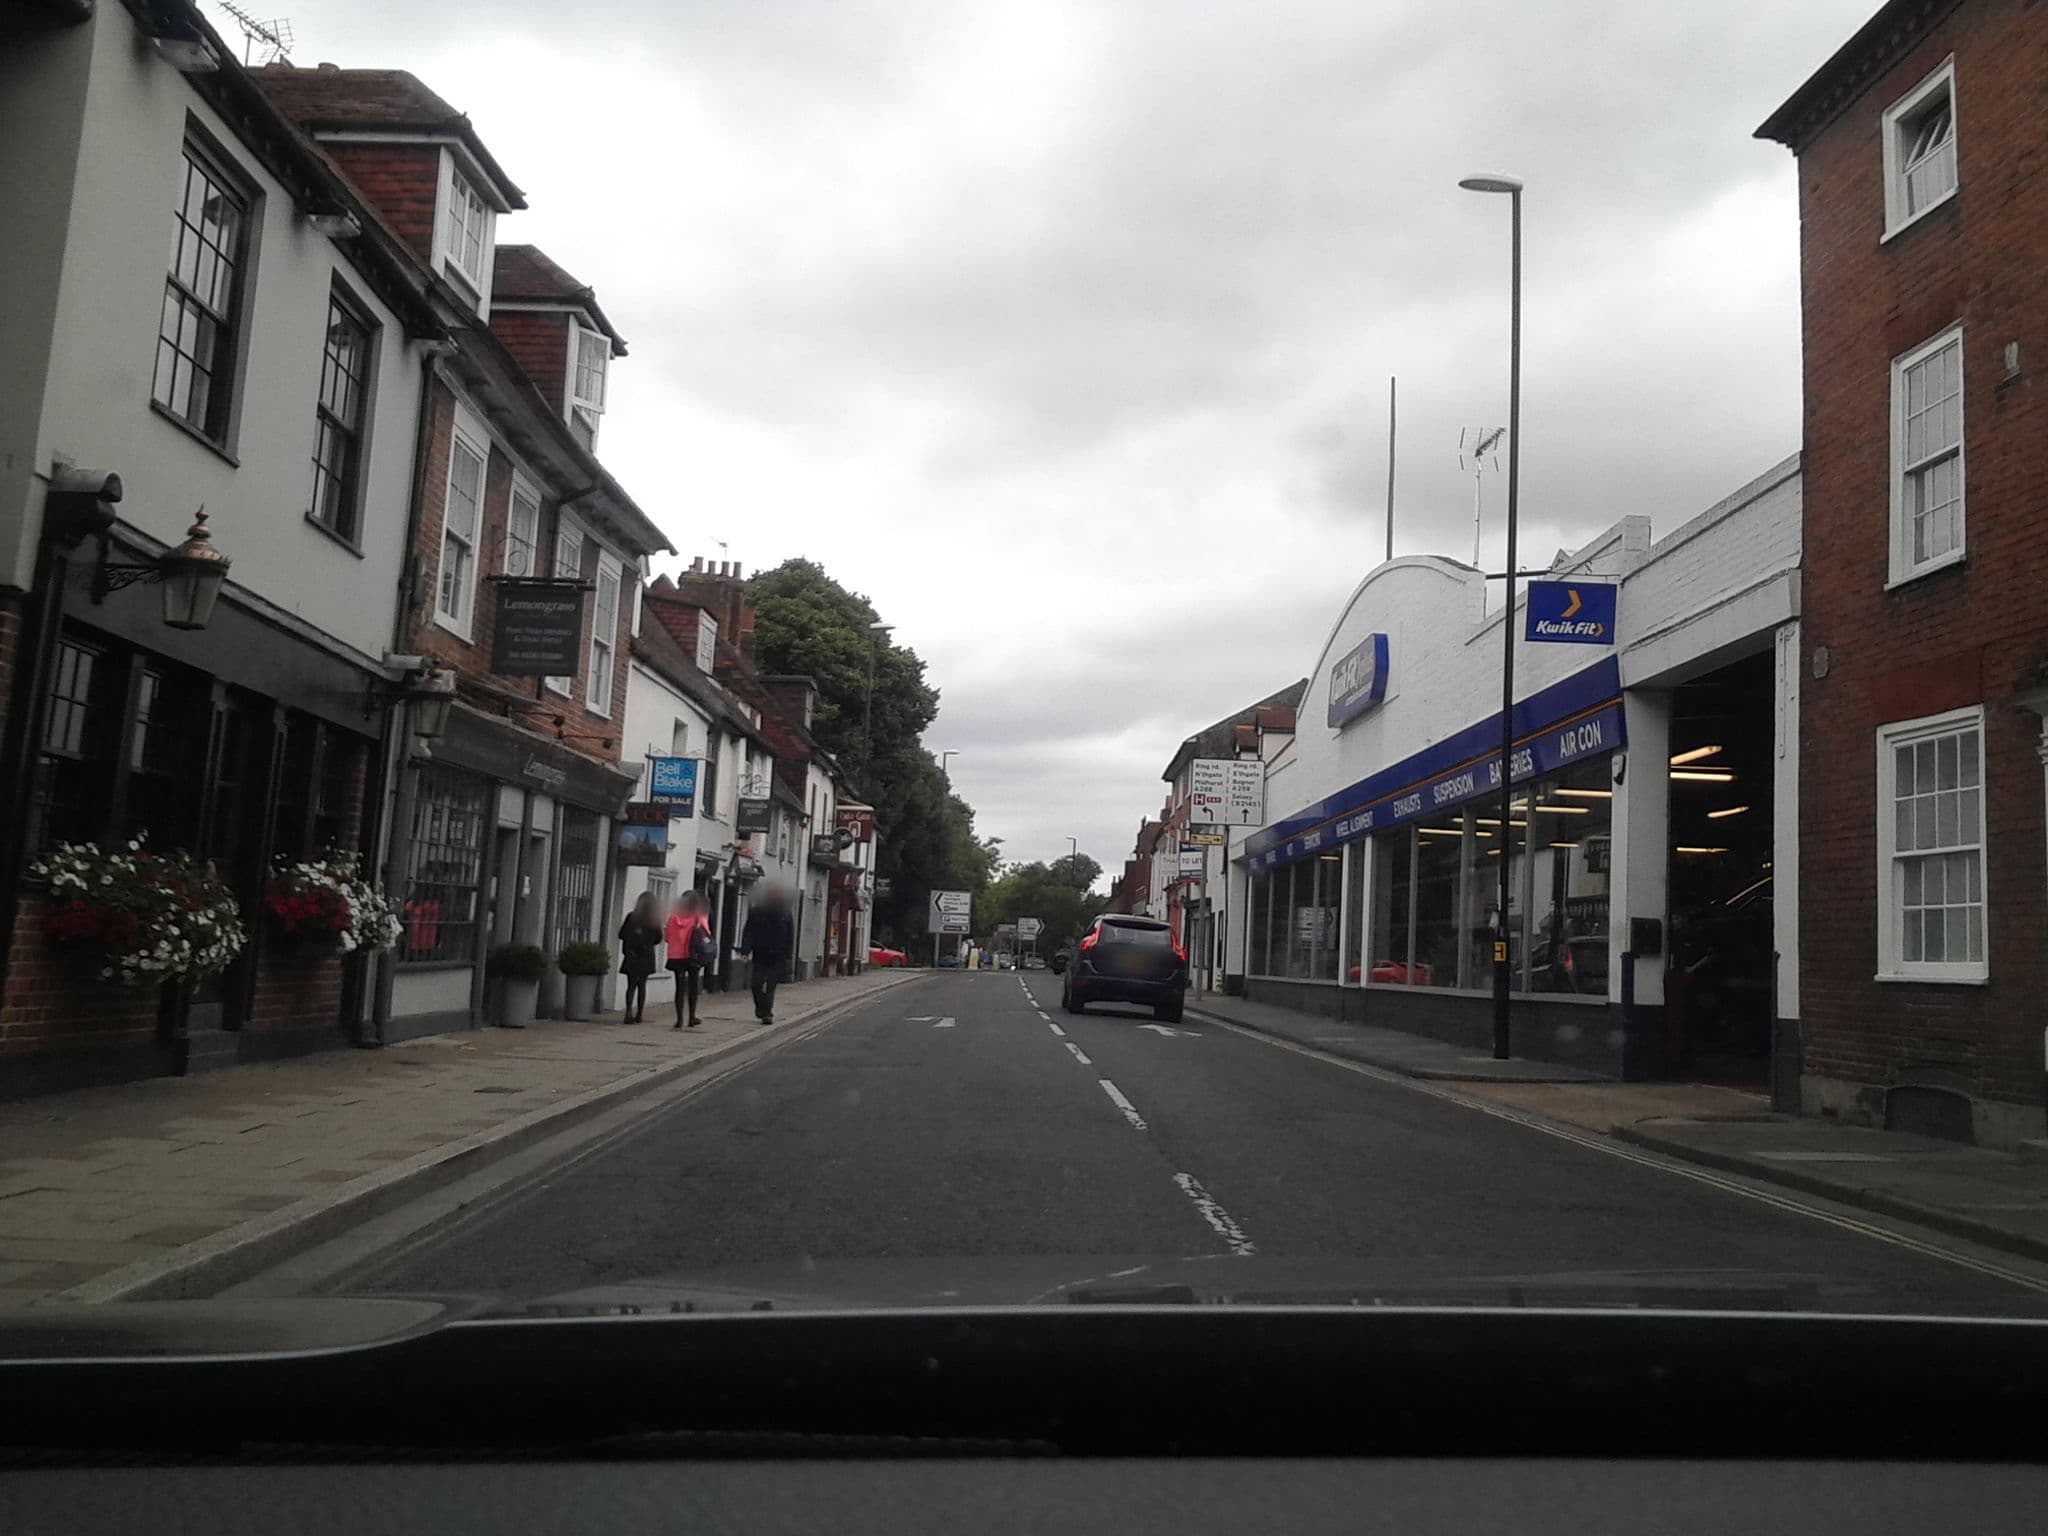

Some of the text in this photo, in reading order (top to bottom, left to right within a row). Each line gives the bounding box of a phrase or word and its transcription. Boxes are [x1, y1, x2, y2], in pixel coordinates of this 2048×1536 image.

[1559, 719, 1602, 759] AIR CON
[655, 761, 682, 775] Bell
[653, 774, 693, 789] Blake
[652, 796, 692, 805] FOR SALE
